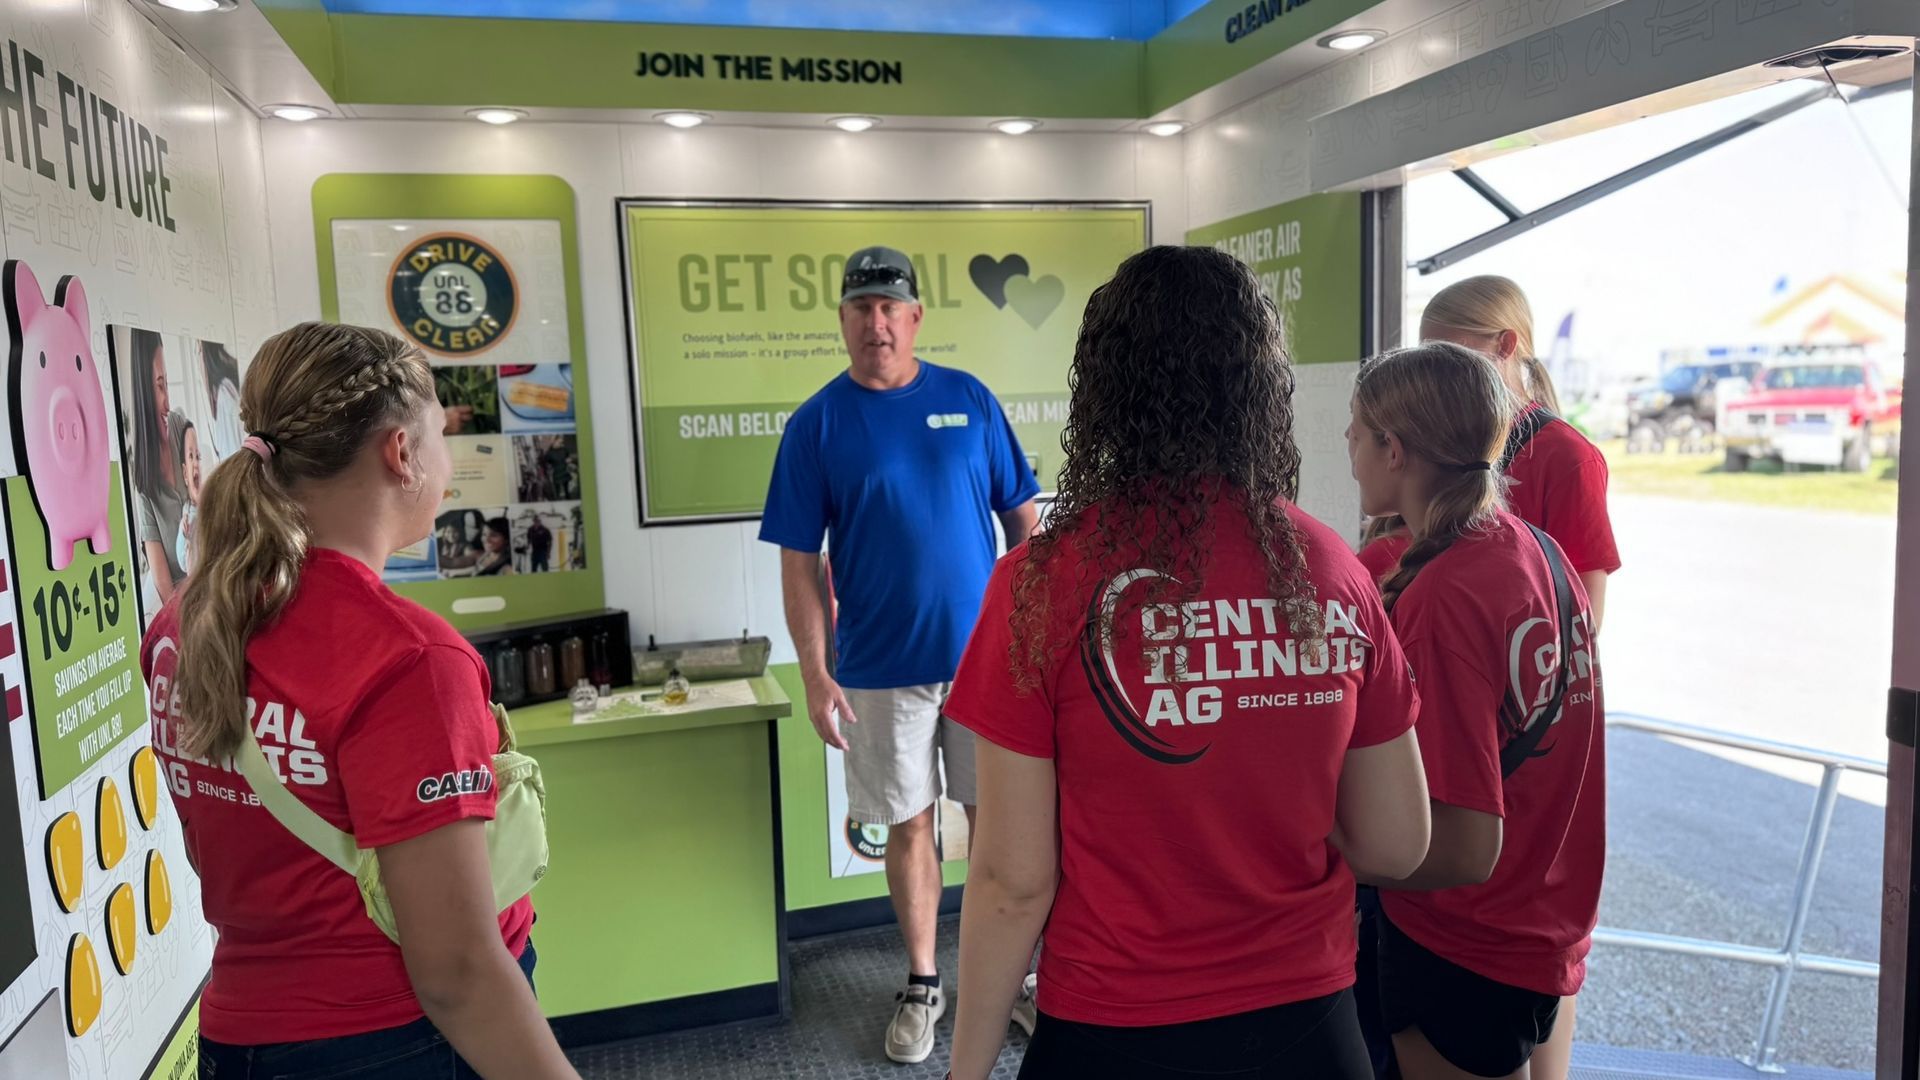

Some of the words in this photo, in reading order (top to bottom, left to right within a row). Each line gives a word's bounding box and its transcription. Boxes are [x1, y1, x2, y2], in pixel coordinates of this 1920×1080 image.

[1225, 0, 1283, 43] CLEAN
[635, 52, 704, 78] JOIN
[712, 54, 773, 80] THE
[780, 57, 903, 84] MISSION
[57, 71, 177, 233] FUTURE
[1275, 220, 1301, 258] AIR
[409, 242, 493, 273] DRIVE
[678, 253, 773, 313] GET
[787, 253, 962, 311] SOAL
[1282, 267, 1302, 301] AS
[413, 318, 500, 349] CLEAN
[682, 333, 725, 345] Choosing
[767, 332, 784, 342] like
[786, 331, 801, 341] the
[803, 332, 840, 343] amazing
[692, 349, 712, 359] solo
[713, 349, 749, 359] mission
[783, 349, 809, 360] group
[811, 346, 836, 357] effort
[679, 414, 735, 438] SCAN
[1003, 401, 1039, 423] EAN
[1141, 599, 1362, 641] CENTAL
[55, 658, 88, 697] SAVINGS
[86, 652, 98, 679] ON
[98, 637, 127, 673] AVERAGE
[56, 703, 78, 740] EACH
[77, 692, 96, 725] TIME
[95, 682, 111, 712] YOU
[109, 675, 123, 703] FILL
[122, 669, 132, 695] UP
[1145, 686, 1222, 727] AG
[1237, 693, 1298, 709] SINCE
[1304, 689, 1343, 705] 1898
[78, 730, 98, 764] WITH
[98, 721, 112, 750] UNL
[197, 780, 237, 802] SINCE
